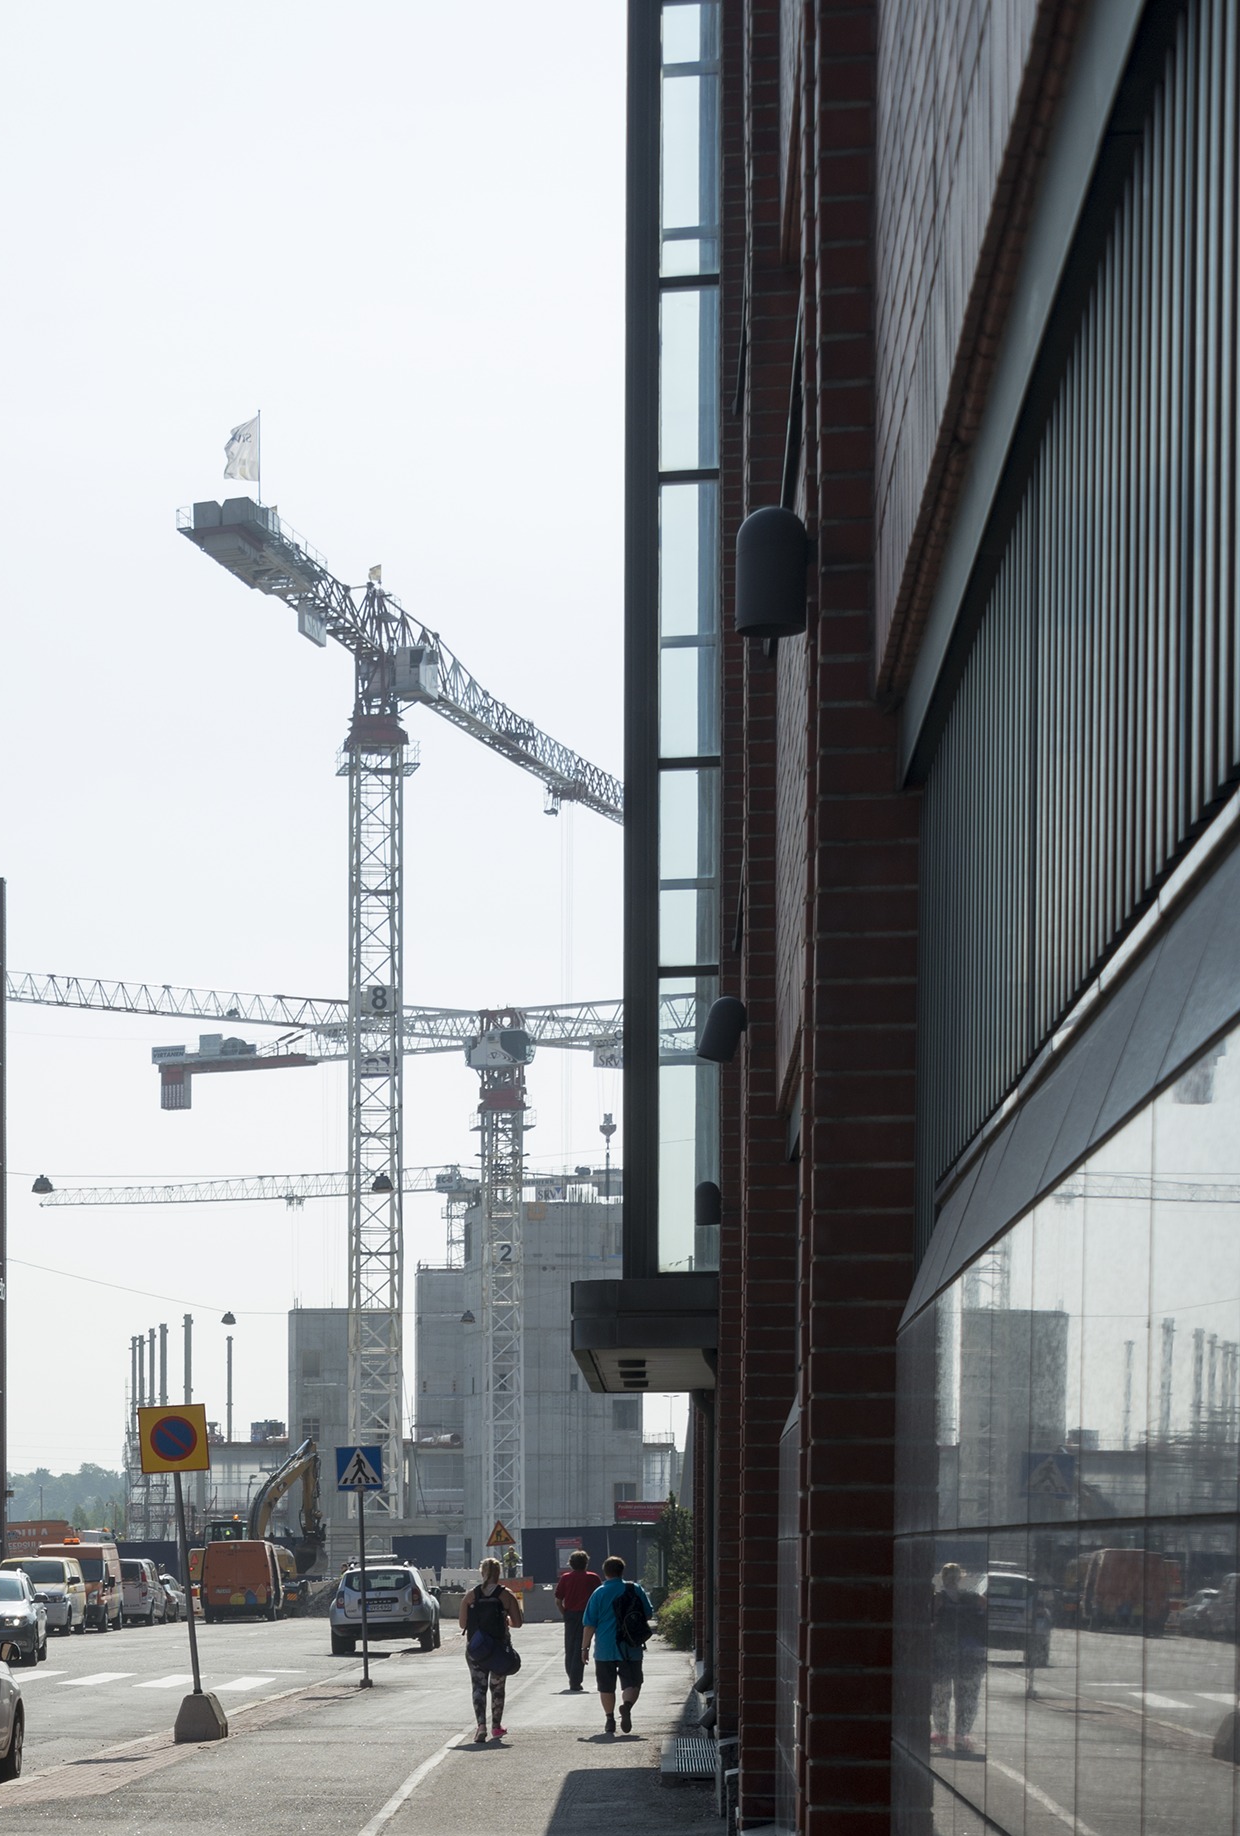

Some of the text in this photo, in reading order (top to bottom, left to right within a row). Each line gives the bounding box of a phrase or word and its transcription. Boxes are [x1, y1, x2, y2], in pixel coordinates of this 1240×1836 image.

[371, 986, 388, 1010] 8
[538, 1190, 556, 1200] SRV
[500, 1244, 512, 1262] 2
